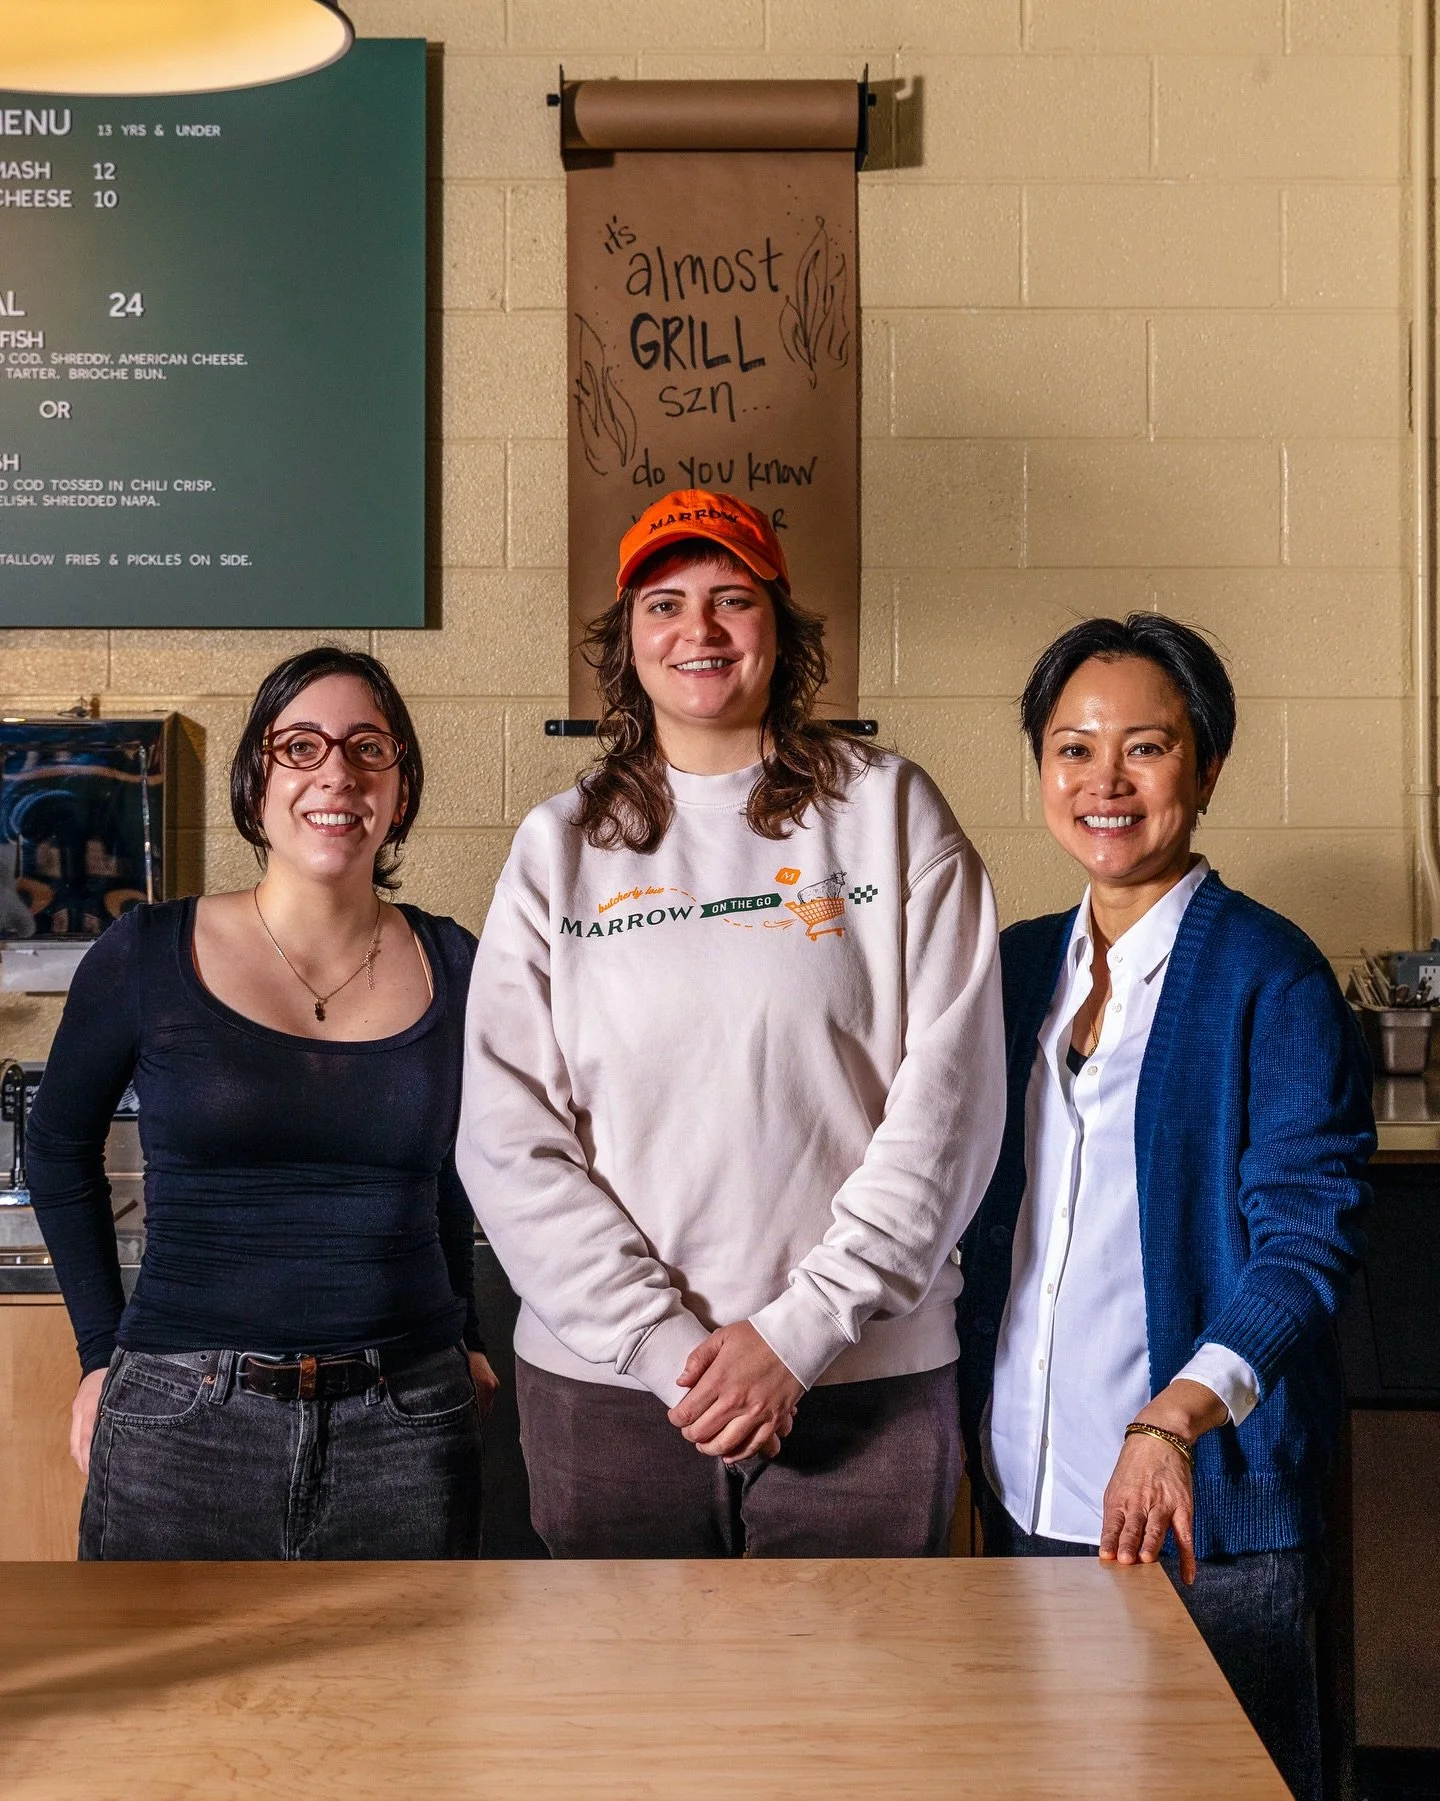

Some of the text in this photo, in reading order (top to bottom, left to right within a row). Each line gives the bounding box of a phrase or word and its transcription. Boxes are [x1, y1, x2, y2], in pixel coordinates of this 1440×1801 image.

[0, 109, 221, 136] ENU 13 YRS & UNDER
[93, 162, 116, 180] 12
[93, 190, 118, 208] 10
[604, 215, 637, 255] it's
[626, 237, 784, 302] almost
[109, 292, 144, 317] 24
[0, 330, 44, 348] FISH
[630, 312, 766, 373] GRILL
[118, 353, 188, 365] AMERICAN
[192, 353, 248, 365] CHEESE.
[6, 367, 167, 380] TARTER. BRIOCHE BUN.
[39, 400, 71, 419] OR
[632, 448, 665, 487] do
[748, 452, 818, 491] know
[13, 479, 45, 491] COD
[50, 479, 104, 491] TOSSED
[108, 480, 124, 491] IN
[131, 479, 168, 491] CHILI
[173, 480, 216, 491] CRISP.
[42, 495, 117, 507] SHREDDED
[121, 495, 161, 507] NAPA.
[649, 508, 740, 535] MARROW
[0, 554, 253, 566] TALLOW FRIES & PICKLES ON SIDE.
[559, 896, 772, 938] MARROW ON THE GO
